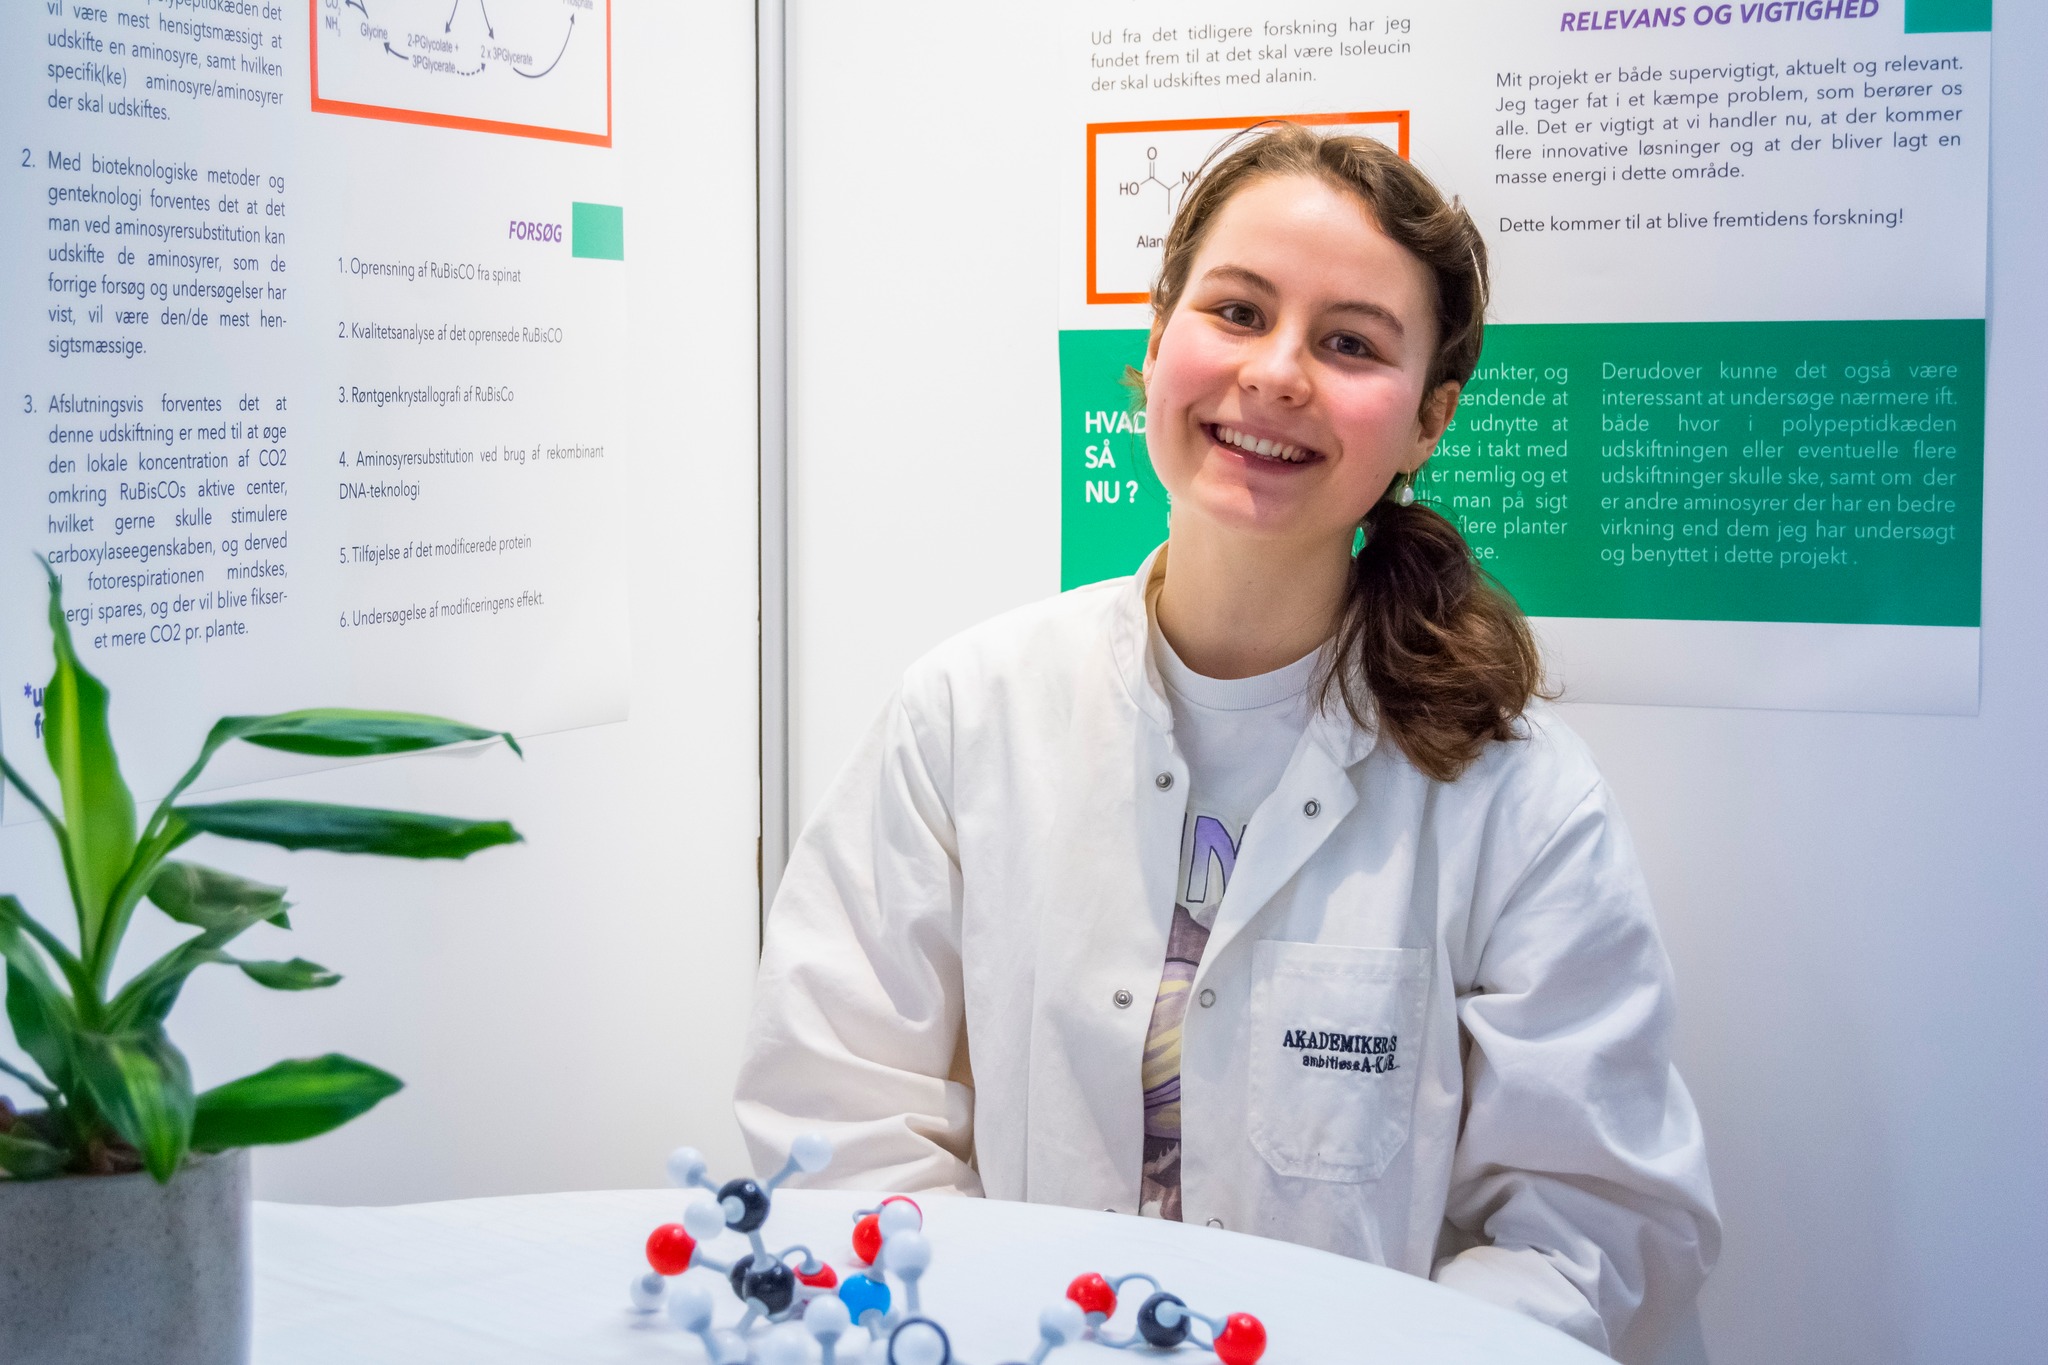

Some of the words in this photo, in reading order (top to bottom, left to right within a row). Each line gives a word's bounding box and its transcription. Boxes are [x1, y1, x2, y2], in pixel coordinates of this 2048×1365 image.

[1561, 5, 1686, 32] RELEVANS
[1694, 3, 1731, 26] OG
[1741, 0, 1879, 23] VIGTIGHED
[1092, 29, 1112, 46] Ud
[1123, 28, 1141, 43] fra
[1152, 26, 1177, 42] det
[1188, 24, 1252, 43] tidligere
[1264, 19, 1337, 37] forskning
[1349, 16, 1374, 32] har
[1385, 17, 1410, 35] jeg
[48, 31, 103, 53] udskifte
[109, 41, 125, 55] en
[132, 42, 201, 69] aminosyre,
[207, 54, 236, 71] samt
[241, 54, 282, 77] hvilken
[48, 63, 126, 89] specifik(ke)
[146, 76, 283, 108] aminosyre/aminosyrer
[1091, 76, 1116, 91] der
[1121, 73, 1148, 90] skal
[1154, 70, 1220, 89] udskiftes
[1226, 68, 1260, 85] med
[1266, 67, 1316, 84] alanin.
[1497, 72, 1522, 87] Mit
[1529, 69, 1588, 91] projekt
[1595, 72, 1611, 84] er
[1619, 65, 1662, 83] både
[1670, 62, 1778, 84] supervigtigt,
[1786, 57, 1846, 76] aktuelt
[1853, 61, 1876, 78] og
[1885, 55, 1962, 72] relevant.
[48, 89, 73, 110] der
[78, 93, 103, 113] skal
[109, 97, 170, 121] udskiftes.
[1496, 120, 1528, 136] alle.
[1538, 119, 1566, 135] Det
[1575, 121, 1592, 134] er
[1600, 116, 1654, 137] vigtigt
[1663, 117, 1678, 130] at
[1687, 114, 1699, 129] vi
[1709, 110, 1777, 129] handler
[1786, 114, 1811, 127] nu,
[1821, 111, 1837, 125] at
[1846, 107, 1877, 124] der
[1886, 106, 1962, 123] kommer
[22, 147, 35, 168] 2.
[48, 150, 81, 172] Med
[92, 153, 198, 185] bioteknologiske
[208, 167, 260, 187] metoder
[269, 175, 284, 194] og
[1119, 182, 1140, 195] HO
[49, 217, 79, 232] man
[85, 215, 110, 235] ved
[115, 221, 260, 243] aminosyrersubstitution
[265, 225, 285, 245] kan
[509, 220, 562, 243] FORSØG
[1500, 217, 1545, 232] Dette
[1551, 215, 1621, 231] kommer
[1626, 213, 1640, 230] til
[1646, 215, 1661, 230] at
[1668, 212, 1708, 229] blive
[1713, 210, 1808, 228] fremtidens
[1814, 208, 1902, 229] forskning!
[338, 257, 347, 274] 1.
[351, 256, 415, 282] Oprensning
[418, 261, 429, 279] af
[431, 262, 474, 280] RuBisCO
[477, 265, 491, 281] fra
[493, 269, 521, 286] spinat
[48, 272, 96, 299] forrige
[101, 273, 145, 301] forsøg
[150, 282, 167, 301] og
[173, 278, 263, 304] undersøgelser
[268, 281, 286, 300] har
[49, 335, 146, 359] sigtsmæssige.
[1602, 360, 1702, 379] Derudover
[1720, 360, 1777, 379] kunne
[1795, 360, 1825, 379] det
[1845, 360, 1890, 384] også
[1911, 366, 1957, 378] være
[24, 393, 36, 413] 3.
[49, 392, 143, 418] Afslutningsvis
[161, 393, 222, 413] forventes
[239, 393, 259, 412] det
[276, 396, 287, 412] at
[339, 385, 348, 403] 3.
[352, 385, 460, 408] Røntgenkrystallografi
[464, 385, 473, 403] af
[475, 386, 513, 402] RuBisCo
[1085, 411, 1147, 434] HVAD
[1602, 413, 1649, 432] både
[1679, 413, 1719, 432] hvor
[1783, 413, 1956, 437] polypeptidkæden
[49, 454, 75, 474] den
[87, 453, 127, 472] lokale
[139, 451, 228, 471] koncentration
[238, 448, 250, 468] af
[259, 448, 286, 467] CO2
[339, 450, 349, 467] 4.
[356, 448, 473, 471] Aminosyrersubstitution
[480, 446, 497, 462] ved
[504, 446, 525, 465] brug
[532, 443, 540, 461] af
[547, 444, 603, 460] rekombinant
[1085, 439, 1116, 468] SÅ
[340, 479, 419, 501] DNA-teknologi
[1432, 470, 1449, 483] er
[1455, 465, 1515, 488] nemlig
[1521, 470, 1544, 488] og
[1551, 468, 1567, 483] et
[1602, 465, 1723, 489] udskiftninger
[1729, 466, 1782, 485] skulle
[1789, 466, 1823, 487] ske,
[1830, 470, 1875, 485] samt
[1882, 473, 1911, 485] om
[1924, 467, 1956, 485] der
[48, 484, 106, 508] omkring
[120, 480, 186, 501] RuBisCOs
[198, 479, 235, 498] aktive
[247, 479, 287, 496] center,
[1085, 481, 1120, 503] NU
[1601, 497, 1619, 510] er
[1625, 491, 1678, 510] andre
[1684, 497, 1787, 516] aminosyrer
[1794, 493, 1825, 511] der
[1832, 492, 1861, 512] har
[1868, 500, 1890, 512] en
[1898, 493, 1955, 512] bedre
[1601, 517, 1674, 541] virkning
[1683, 518, 1718, 536] end
[1727, 518, 1768, 537] dem
[1778, 525, 1806, 543] jeg
[1816, 519, 1845, 538] har
[1855, 520, 1954, 544] undersøgt
[48, 537, 216, 566] carboxylaseegenskaben,
[222, 539, 238, 558] og
[245, 531, 287, 551] derved
[88, 567, 204, 592] fotorespirationen
[227, 559, 287, 579] mindskes,
[340, 611, 349, 628] 6.
[353, 603, 426, 627] Undersøgelse
[429, 600, 438, 619] af
[441, 597, 514, 617] modificeringens
[517, 590, 544, 608] effekt.
